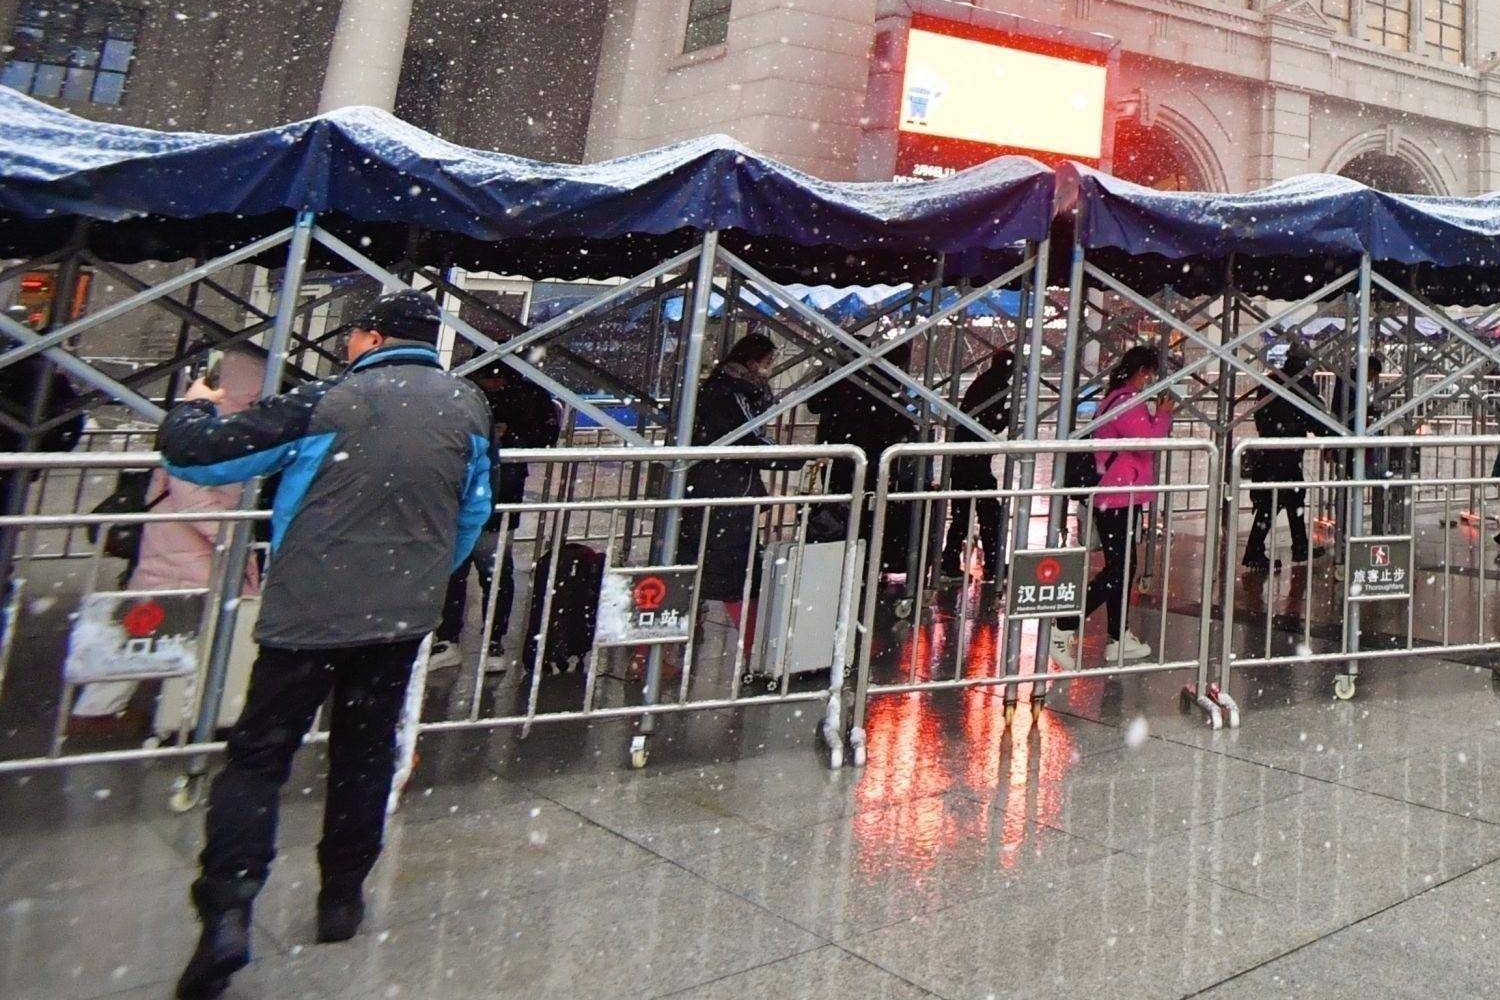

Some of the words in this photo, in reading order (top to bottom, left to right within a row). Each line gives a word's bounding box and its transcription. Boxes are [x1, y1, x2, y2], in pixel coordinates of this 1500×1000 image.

[1353, 567, 1406, 584] 旅客止步
[1017, 582, 1076, 604] 汉口站
